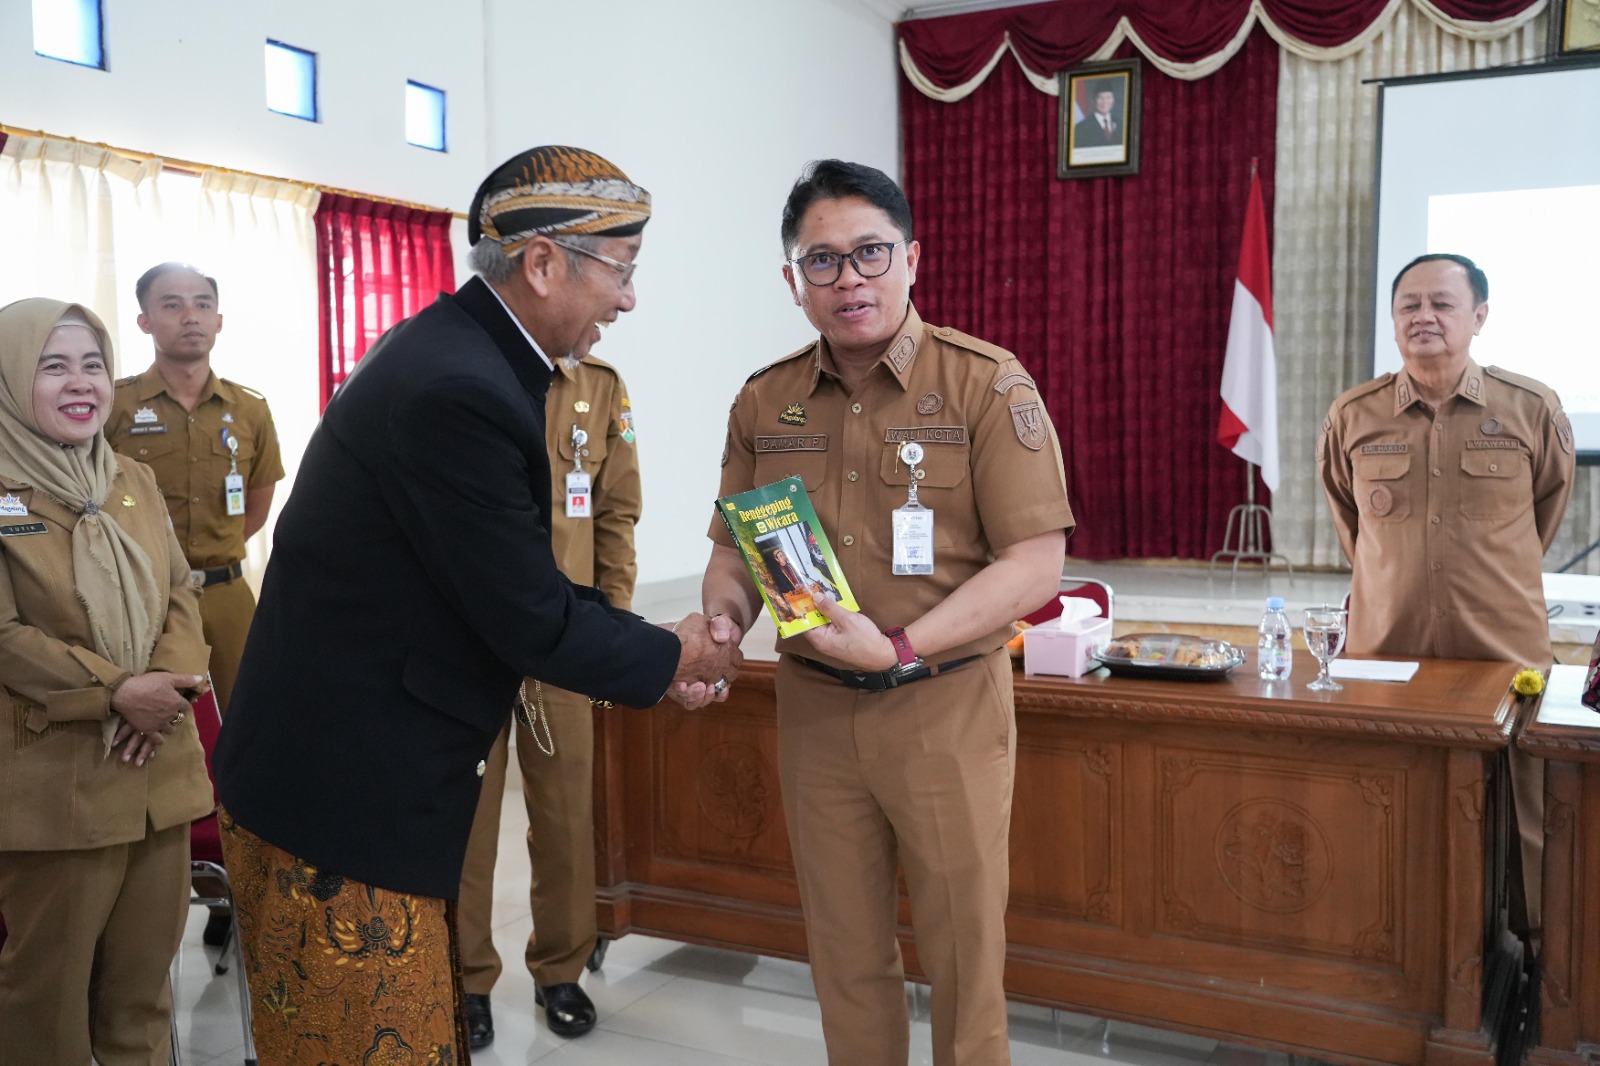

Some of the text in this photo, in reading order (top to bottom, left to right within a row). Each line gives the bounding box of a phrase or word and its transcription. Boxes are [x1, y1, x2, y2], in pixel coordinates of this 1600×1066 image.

[891, 429, 961, 440] WALI KOTA
[762, 438, 819, 449] DAMAR P
[738, 496, 794, 523] Renggeping
[764, 512, 799, 530] Wicara
